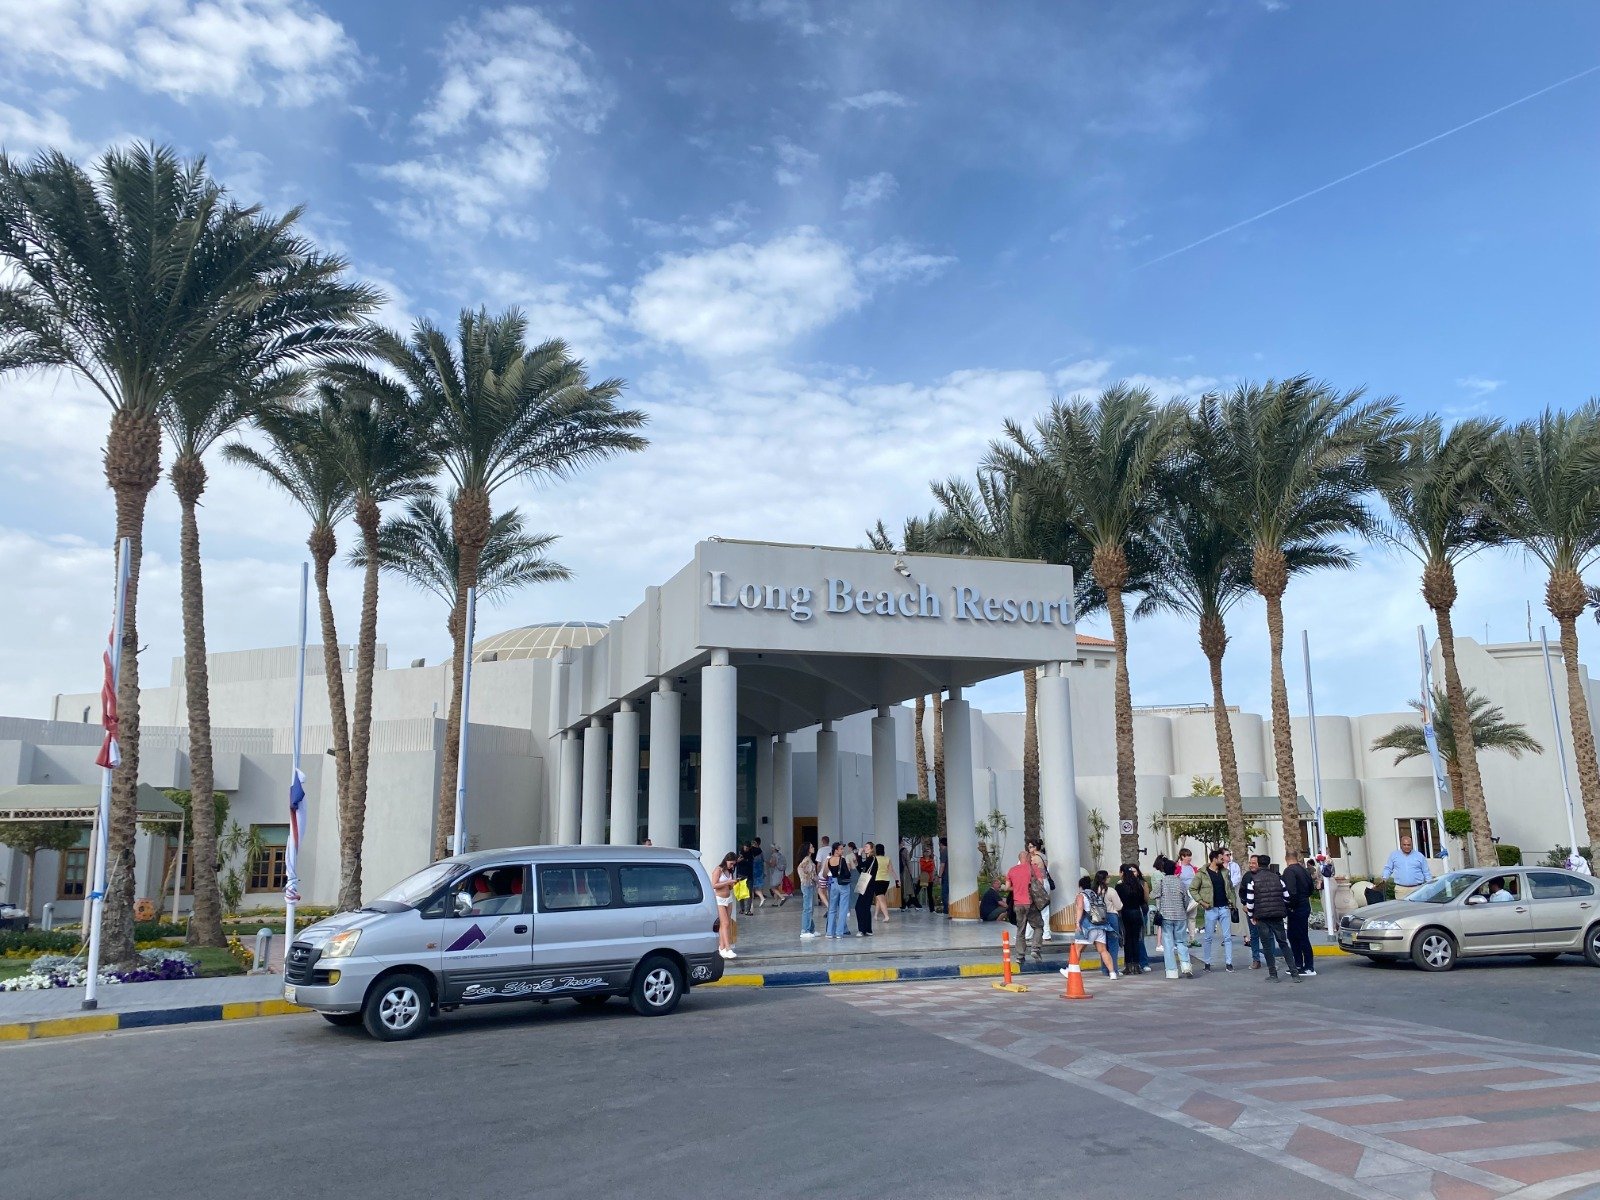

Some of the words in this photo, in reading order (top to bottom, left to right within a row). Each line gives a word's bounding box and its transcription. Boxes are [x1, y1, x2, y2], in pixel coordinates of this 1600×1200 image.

[708, 570, 813, 621] Long
[825, 577, 941, 618] Beach
[953, 585, 1073, 625] Resort
